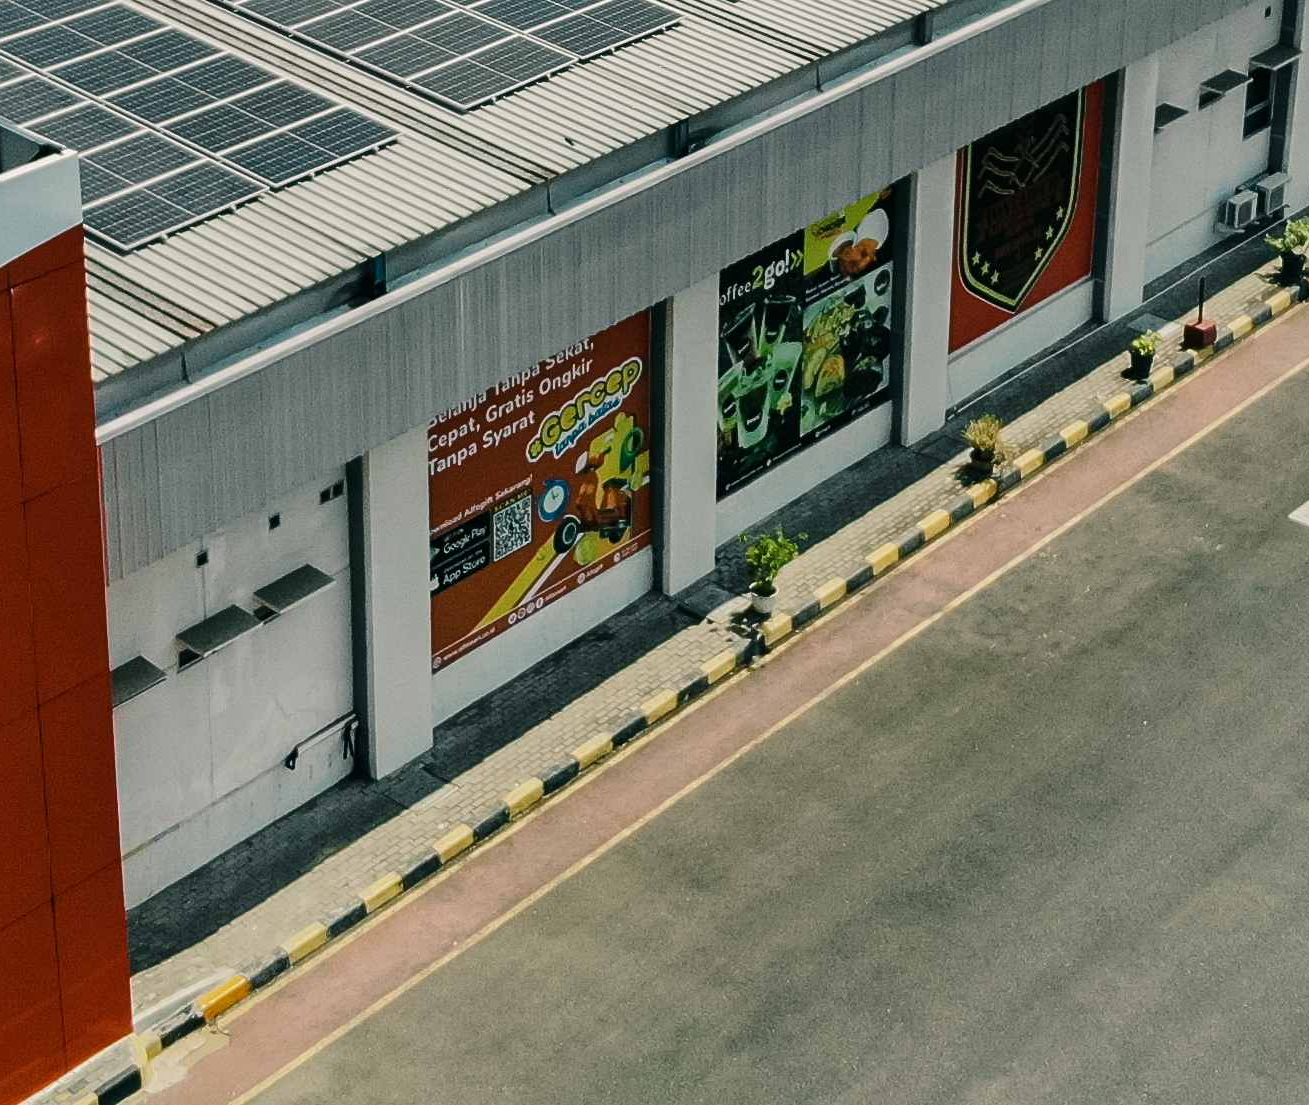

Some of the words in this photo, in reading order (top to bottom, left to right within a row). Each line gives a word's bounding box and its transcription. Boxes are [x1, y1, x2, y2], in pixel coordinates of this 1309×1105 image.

[428, 418, 481, 452] Cepat,
[486, 389, 534, 422] Gratis
[539, 358, 594, 395] Ongkir
[429, 443, 477, 475] Tanpa
[483, 411, 536, 448] Syarat
[443, 534, 470, 554] Google
[443, 570, 462, 585] App
[462, 556, 487, 574] Store
